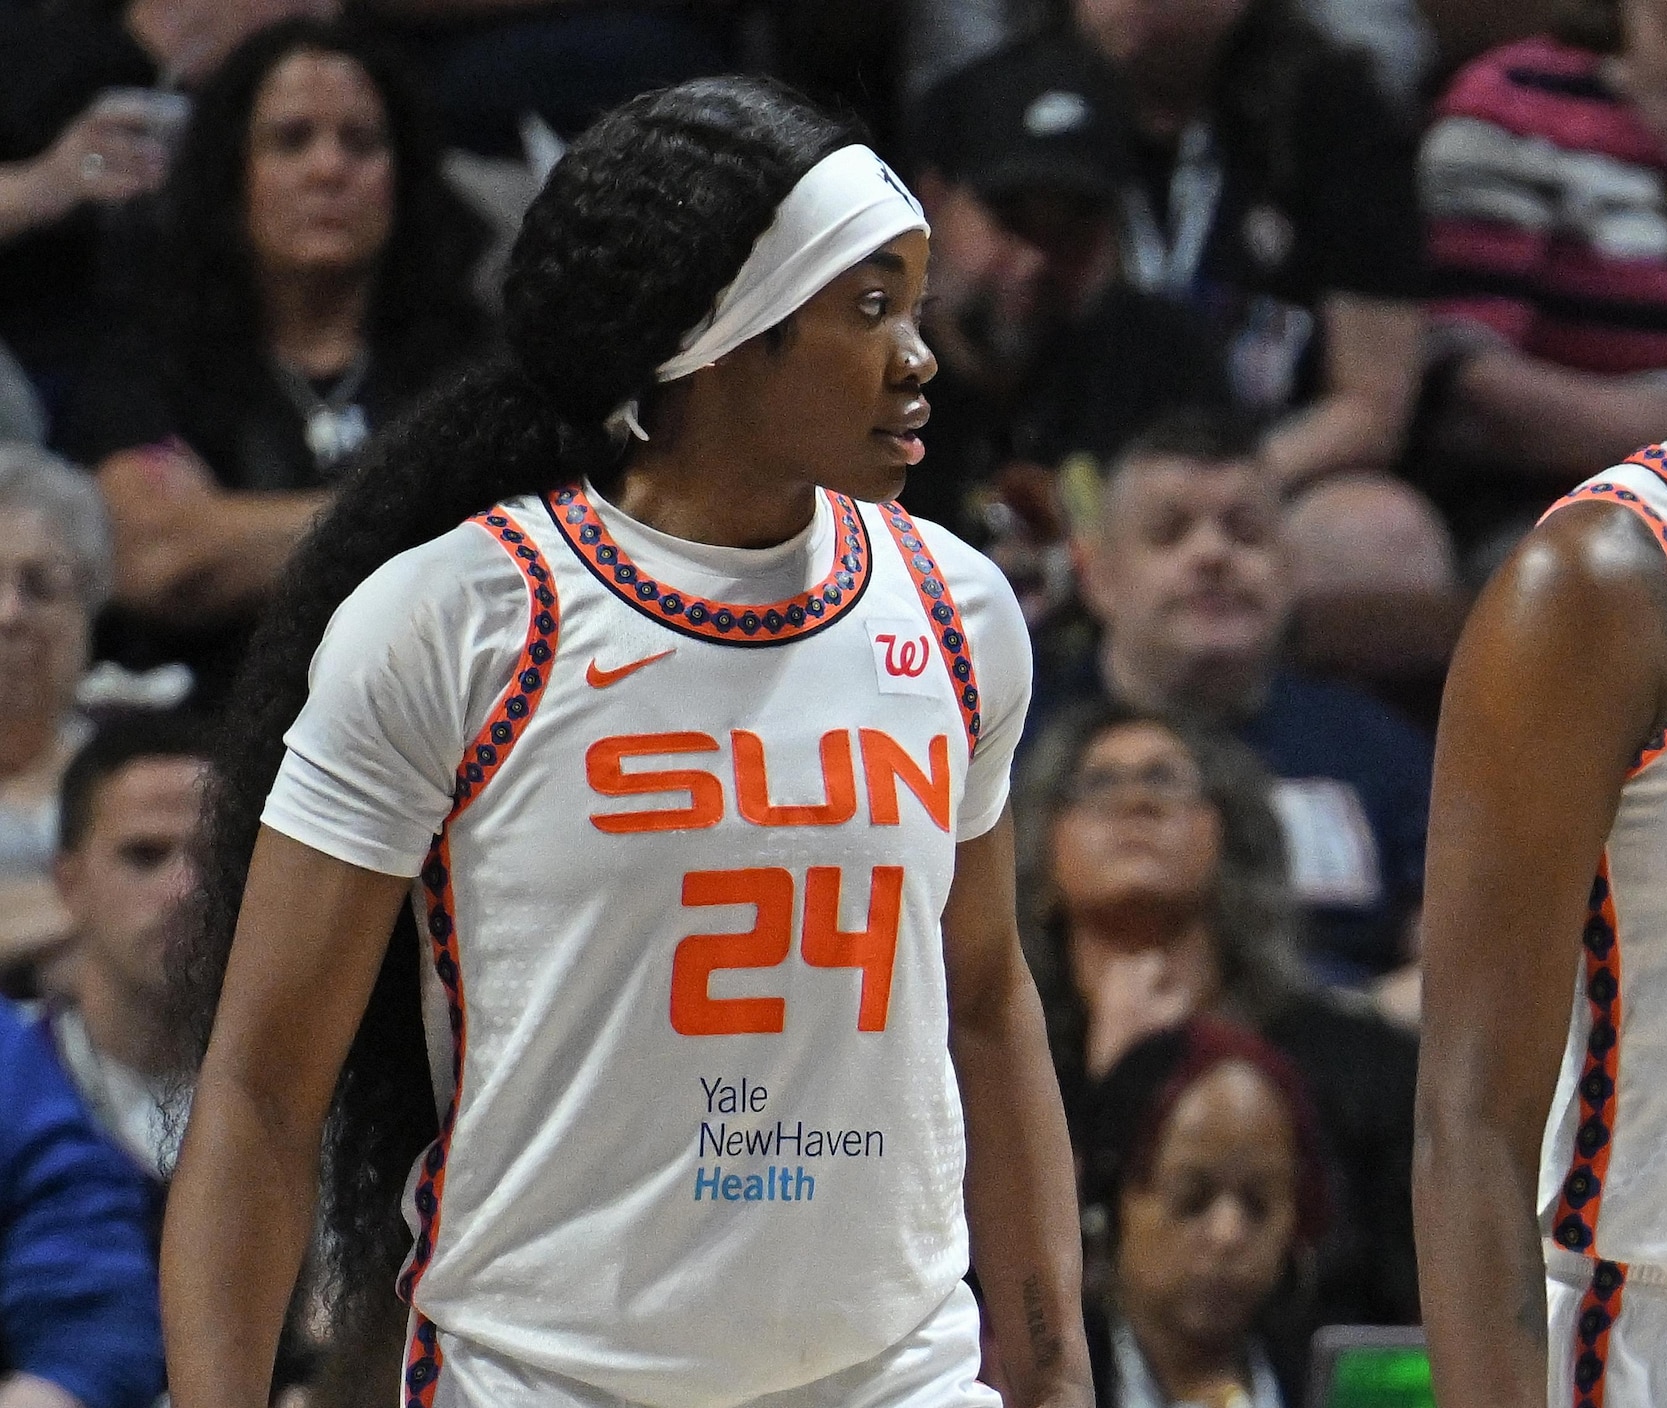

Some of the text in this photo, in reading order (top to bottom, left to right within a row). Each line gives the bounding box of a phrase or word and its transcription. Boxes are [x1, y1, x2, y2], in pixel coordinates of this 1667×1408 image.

[585, 727, 951, 834] SUN
[670, 865, 905, 1036] 24
[700, 1077, 768, 1114] Yale
[700, 1121, 884, 1158] NewHaven
[695, 1166, 815, 1201] Health
